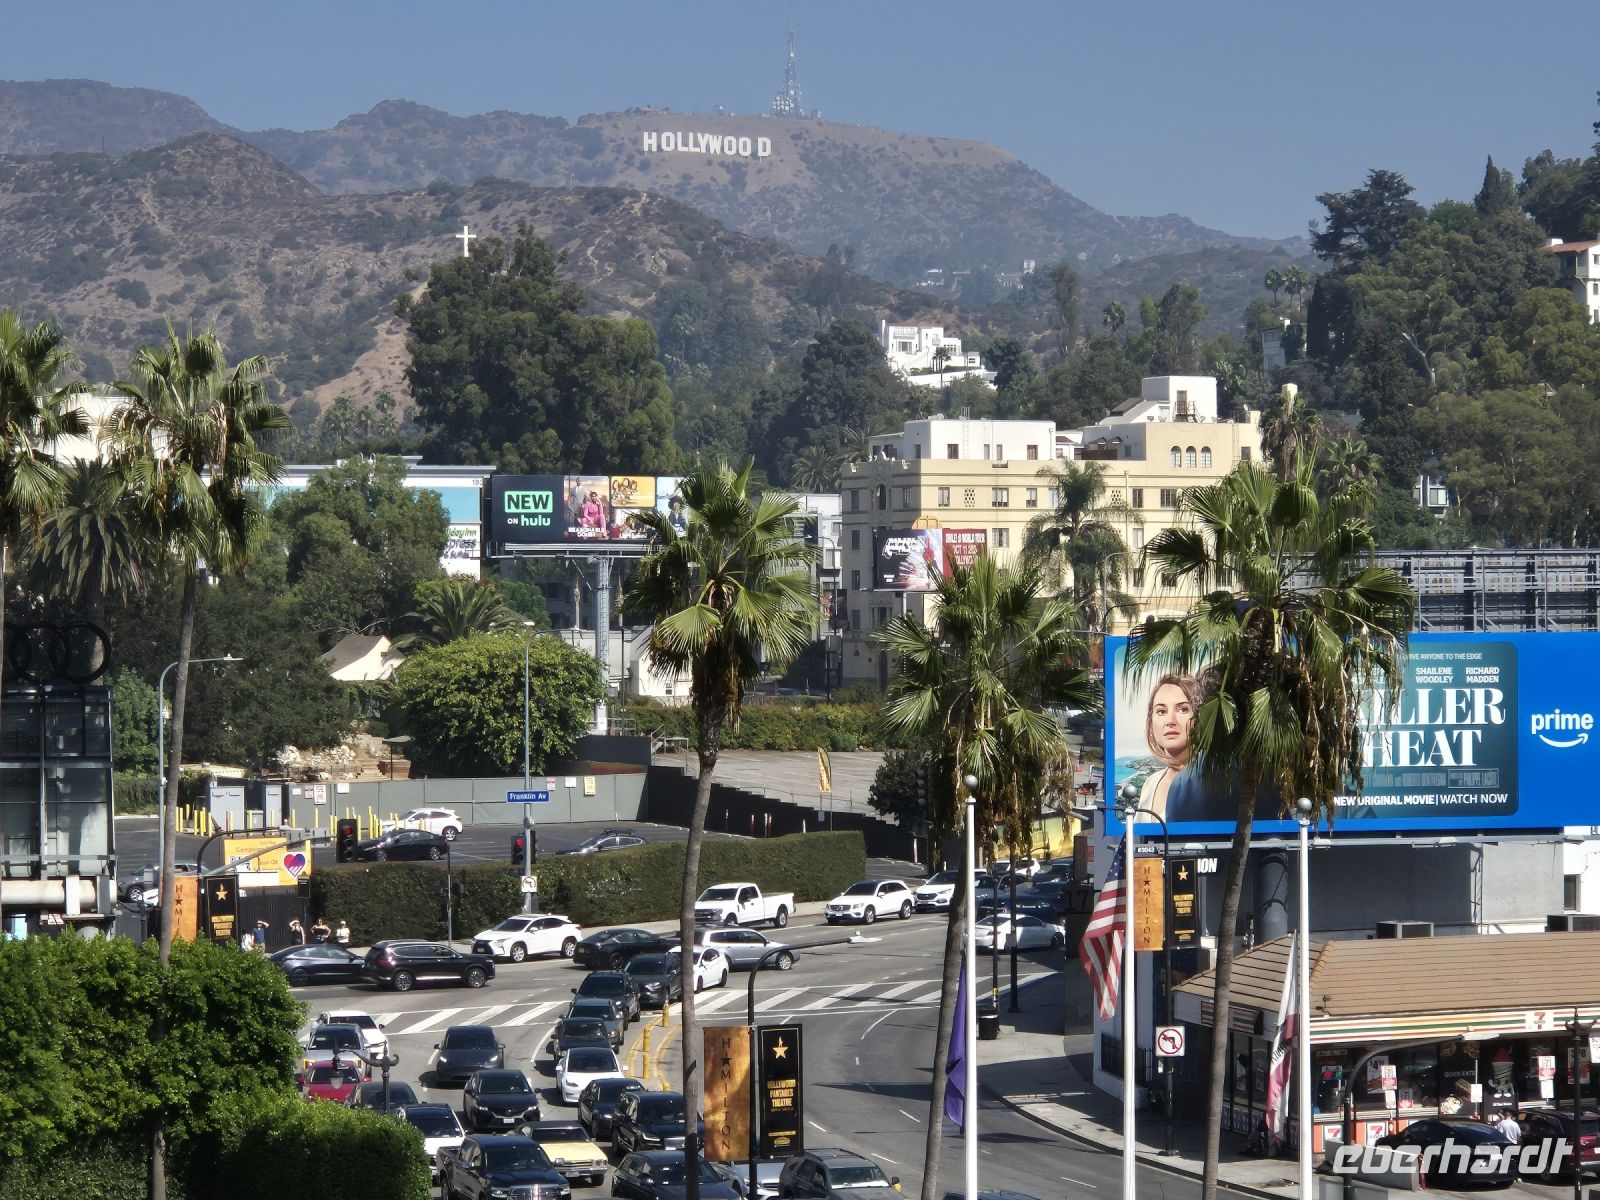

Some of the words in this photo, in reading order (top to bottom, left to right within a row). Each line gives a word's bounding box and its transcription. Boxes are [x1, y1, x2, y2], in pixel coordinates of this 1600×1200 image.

[643, 131, 772, 157] HOLLYWOOD
[507, 494, 550, 510] NEW
[507, 517, 519, 525] ON
[520, 514, 551, 526] hulu
[1416, 667, 1453, 675] SHAILENE
[1465, 666, 1500, 675] RICHARD
[1416, 675, 1454, 683] WOODLEY
[1466, 675, 1500, 683] MADDEN
[1531, 708, 1594, 734] prime
[1361, 729, 1482, 767] HEAT
[509, 792, 536, 800] Franklin
[538, 792, 547, 800] Av
[1334, 796, 1357, 806] NEW
[1358, 795, 1403, 806] ORIGINAL
[1403, 795, 1435, 805] MOVIE
[1440, 794, 1478, 804] WATCH
[1481, 793, 1508, 804] NOW
